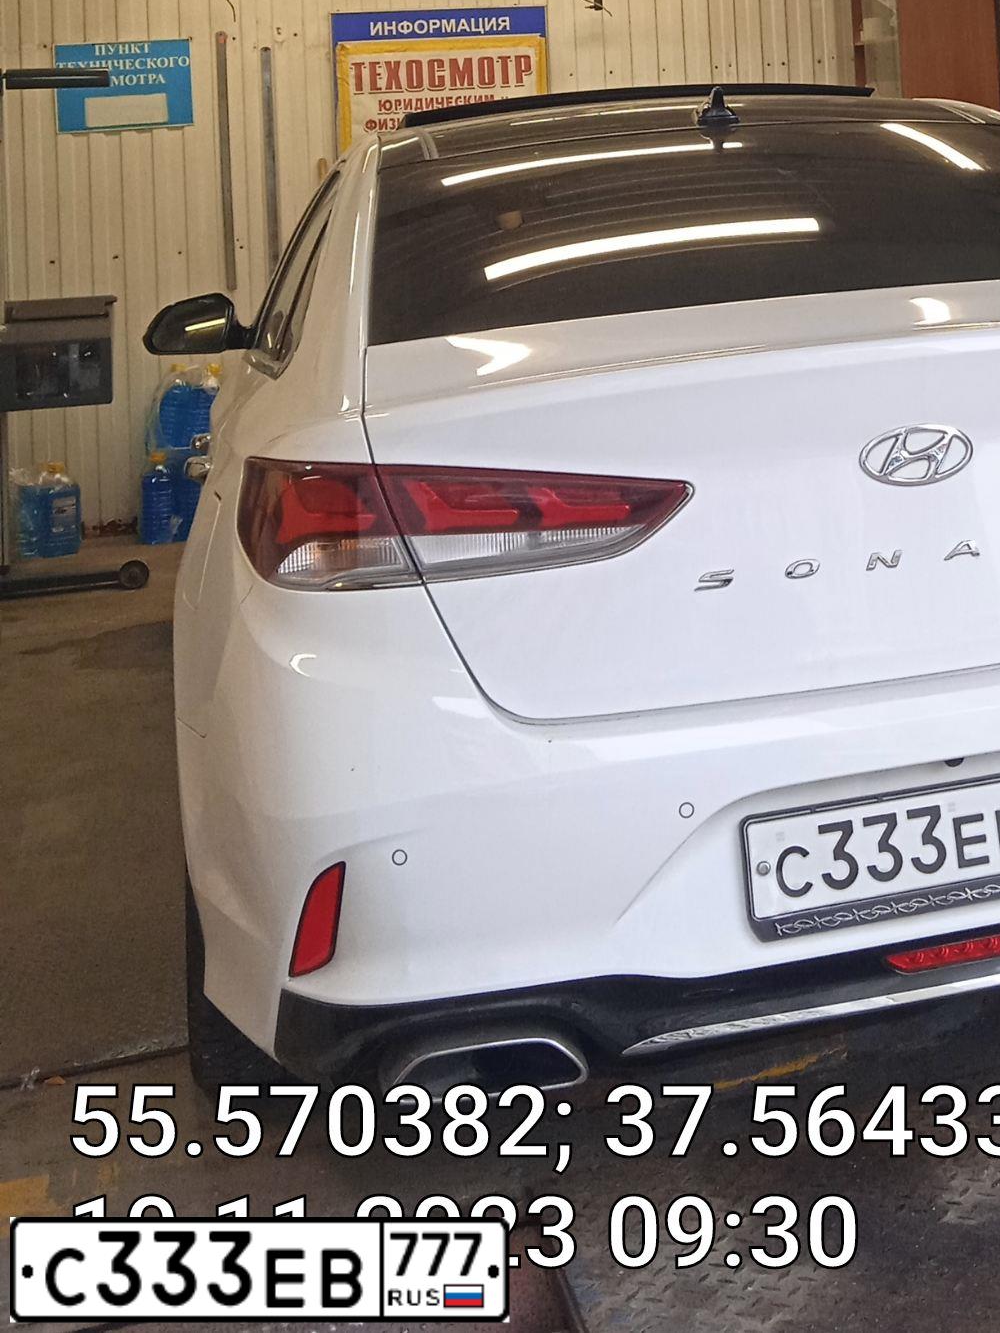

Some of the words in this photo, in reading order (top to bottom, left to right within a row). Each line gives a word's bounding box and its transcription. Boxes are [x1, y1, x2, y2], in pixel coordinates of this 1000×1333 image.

[369, 17, 510, 36] ИНФОРМАЦИЯ
[94, 43, 150, 56] ПУНКТ
[110, 73, 166, 87] МОТРА
[351, 54, 533, 95] ТЕХОСМОТР
